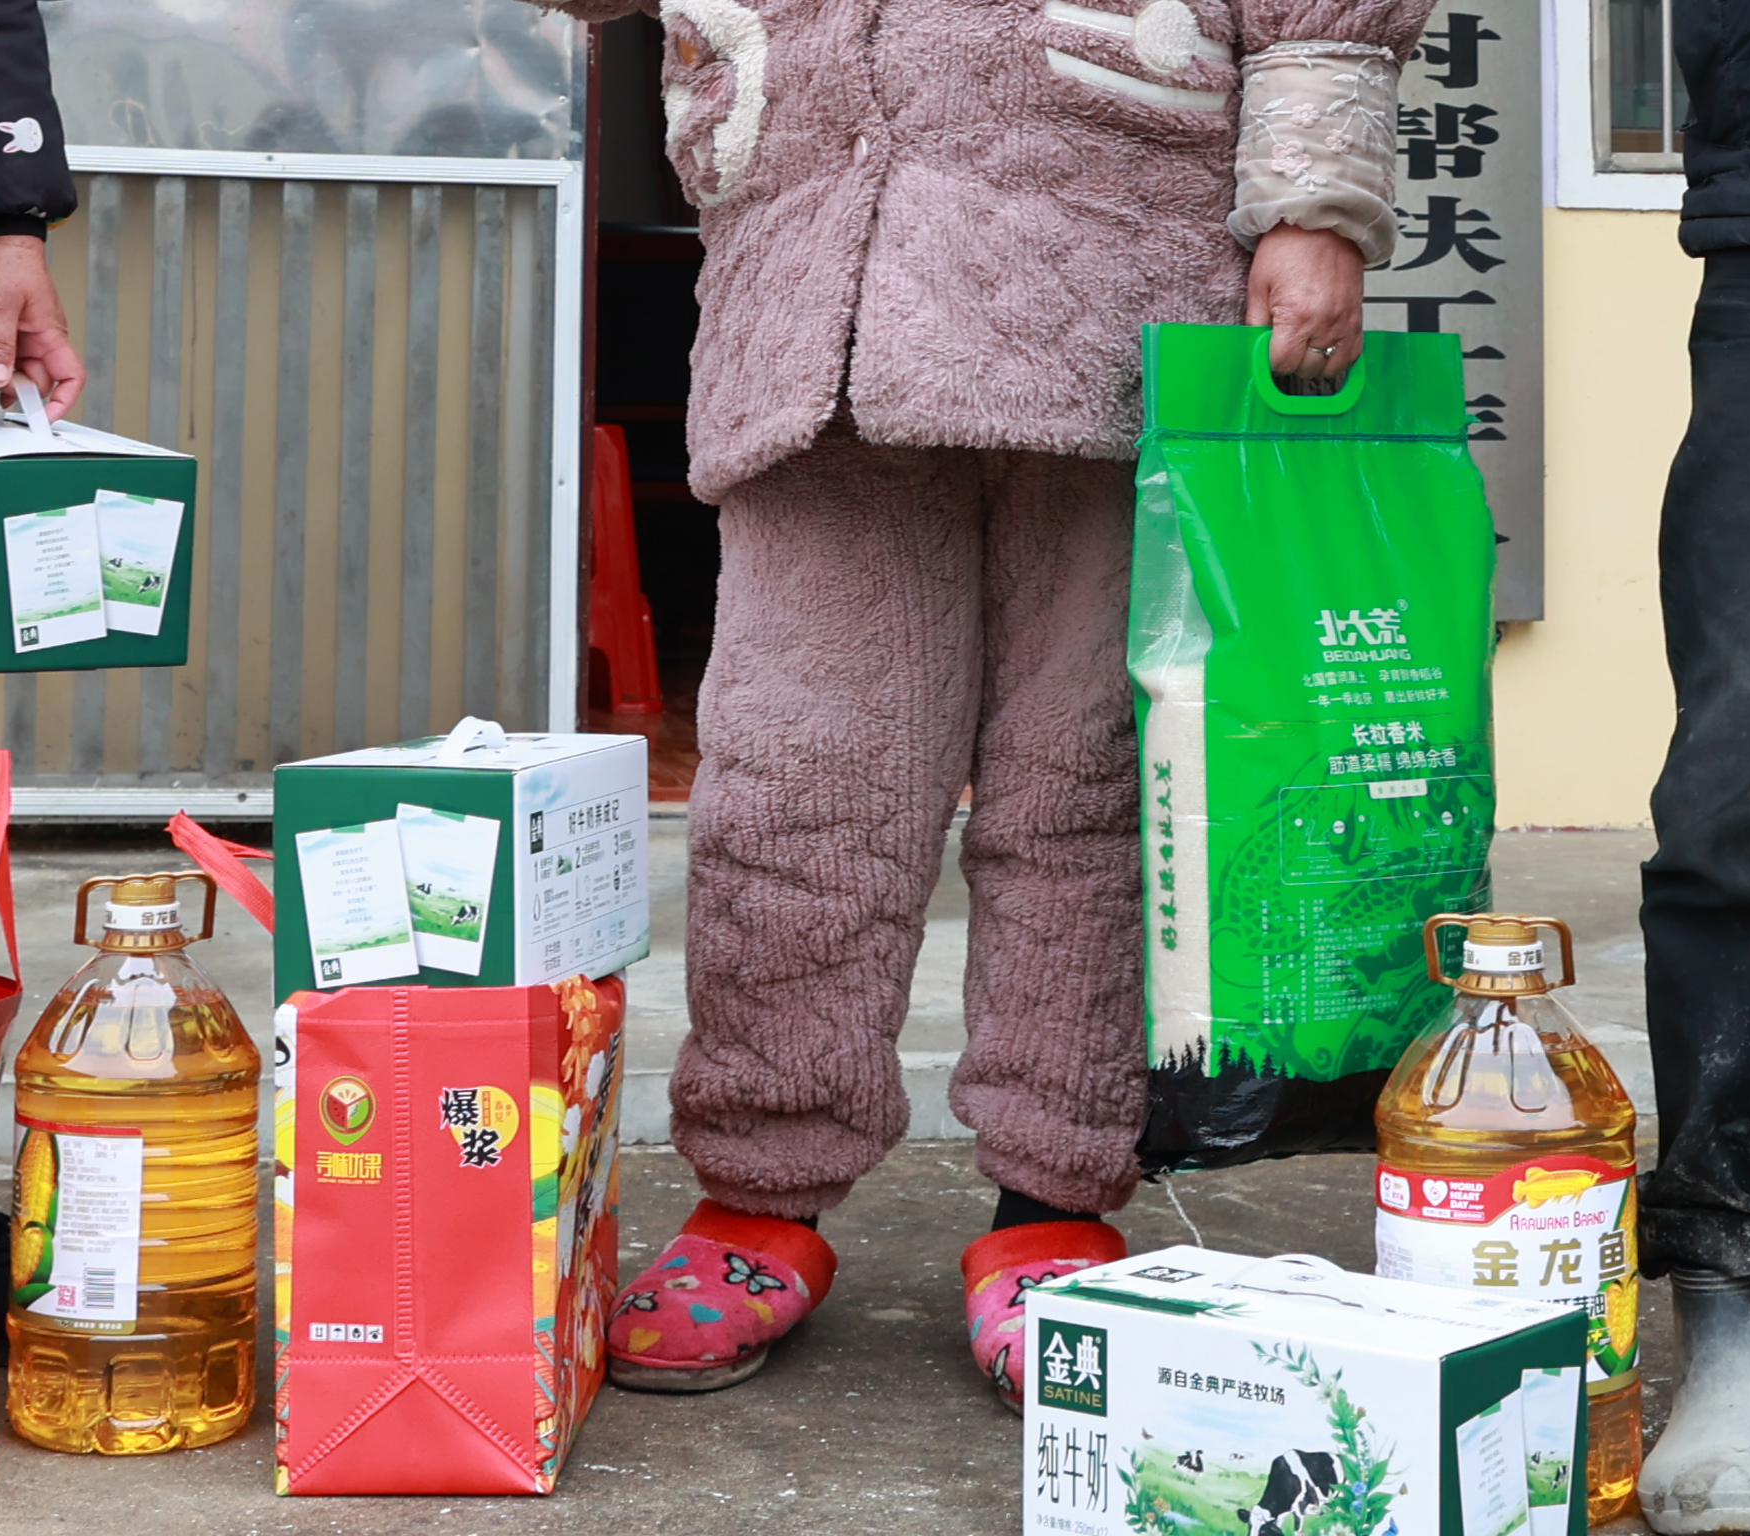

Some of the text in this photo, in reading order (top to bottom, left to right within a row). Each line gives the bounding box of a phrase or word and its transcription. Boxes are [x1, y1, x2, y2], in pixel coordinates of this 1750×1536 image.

[1314, 607, 1407, 646] 北大荒
[1323, 648, 1411, 663] BEIDAHUANG
[1352, 720, 1425, 746] 长粒香米
[1328, 747, 1457, 775] 筋道柔糯 绵绵余香
[568, 799, 620, 836] 好牛奶养成记
[1154, 759, 1178, 952] 好米源自北大荒
[441, 1088, 501, 1166] 爆浆
[317, 1151, 382, 1178] 寻味优果
[1449, 1181, 1484, 1192] WORLD
[1449, 1191, 1480, 1201] HEART
[1449, 1200, 1469, 1209] DAY
[1472, 1230, 1627, 1287] 金龙鱼
[1042, 1331, 1103, 1391] 金典
[1042, 1385, 1103, 1408] SATINE
[1157, 1366, 1285, 1405] 源自金典严选牧场
[1036, 1423, 1109, 1514] 纯牛奶
